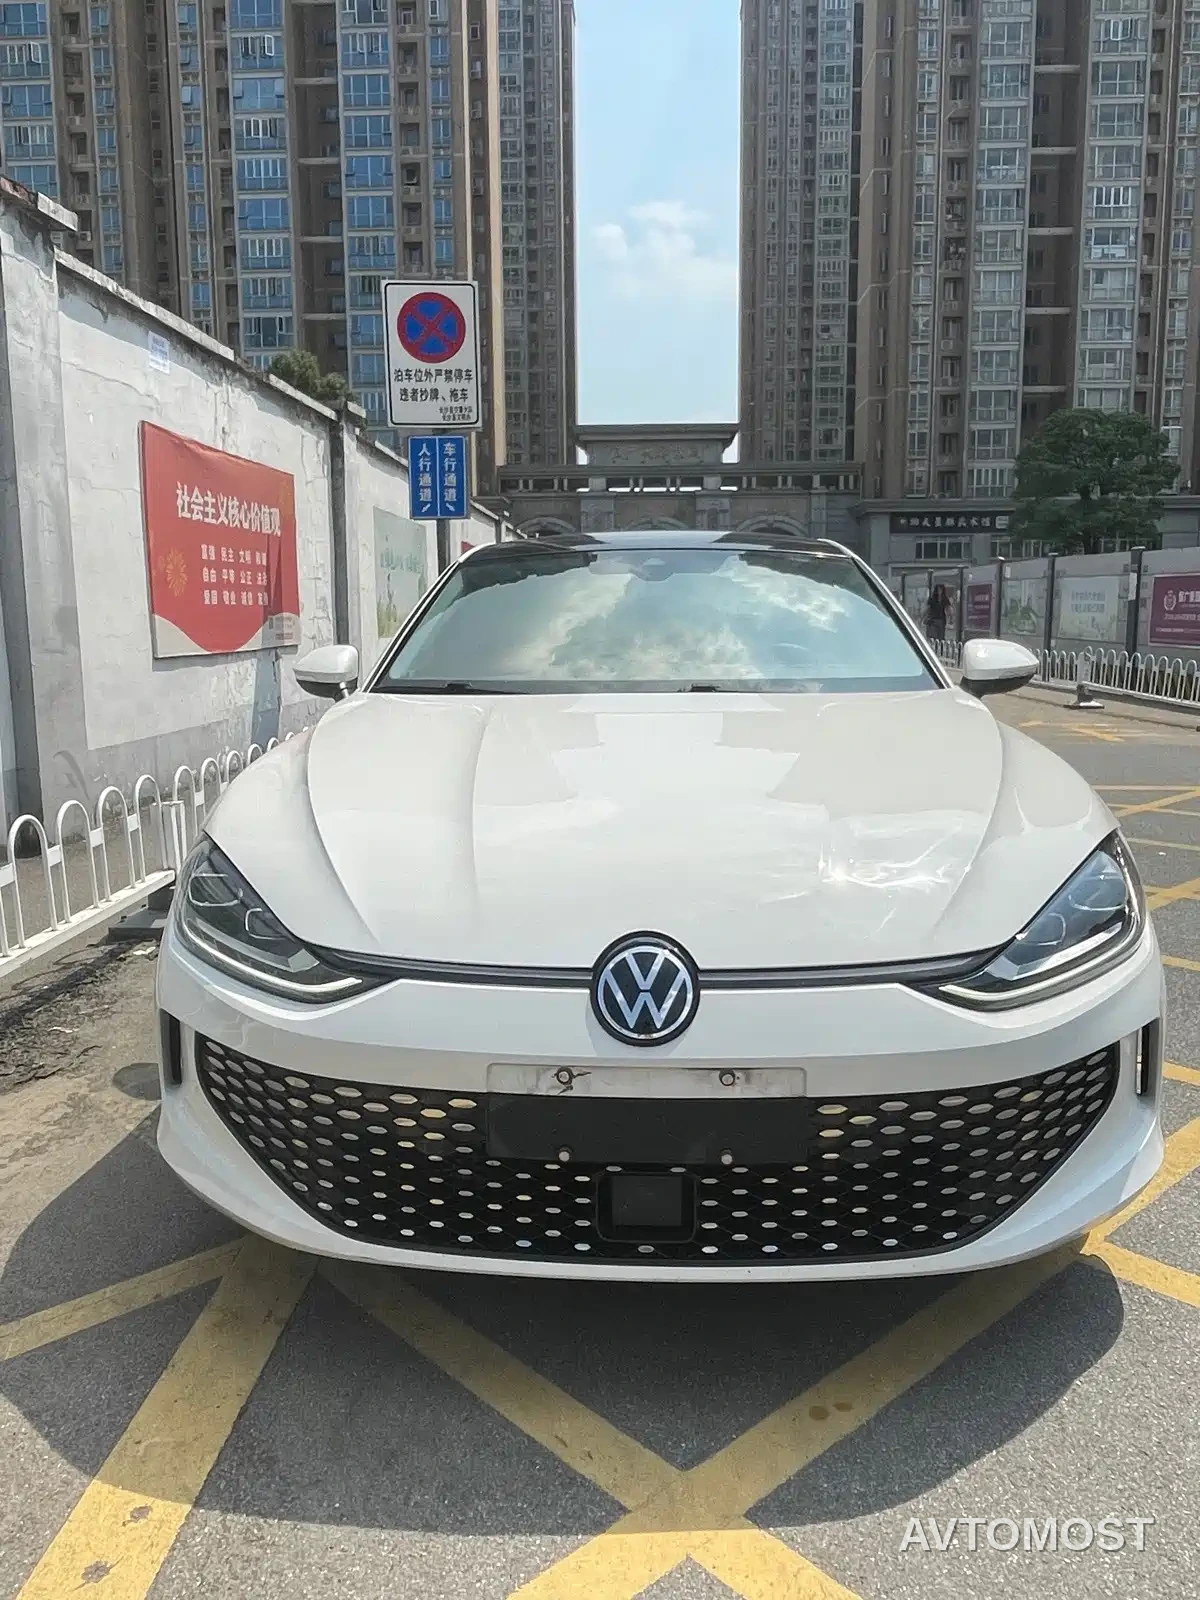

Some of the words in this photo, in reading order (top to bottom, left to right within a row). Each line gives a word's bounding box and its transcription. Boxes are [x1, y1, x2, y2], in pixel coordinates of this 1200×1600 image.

[394, 368, 473, 383] 泊车位外严禁停车
[399, 388, 468, 402] 违者抄牌、拖车
[418, 442, 432, 502] 人行通道
[443, 442, 457, 502] 车行通道
[176, 481, 281, 537] 社会主义核心价值观
[201, 544, 216, 560] 富强
[221, 546, 235, 563] 民主
[239, 548, 252, 565] 文明
[202, 566, 217, 583] 自由
[222, 568, 235, 584] 平等
[240, 570, 253, 585] 公正
